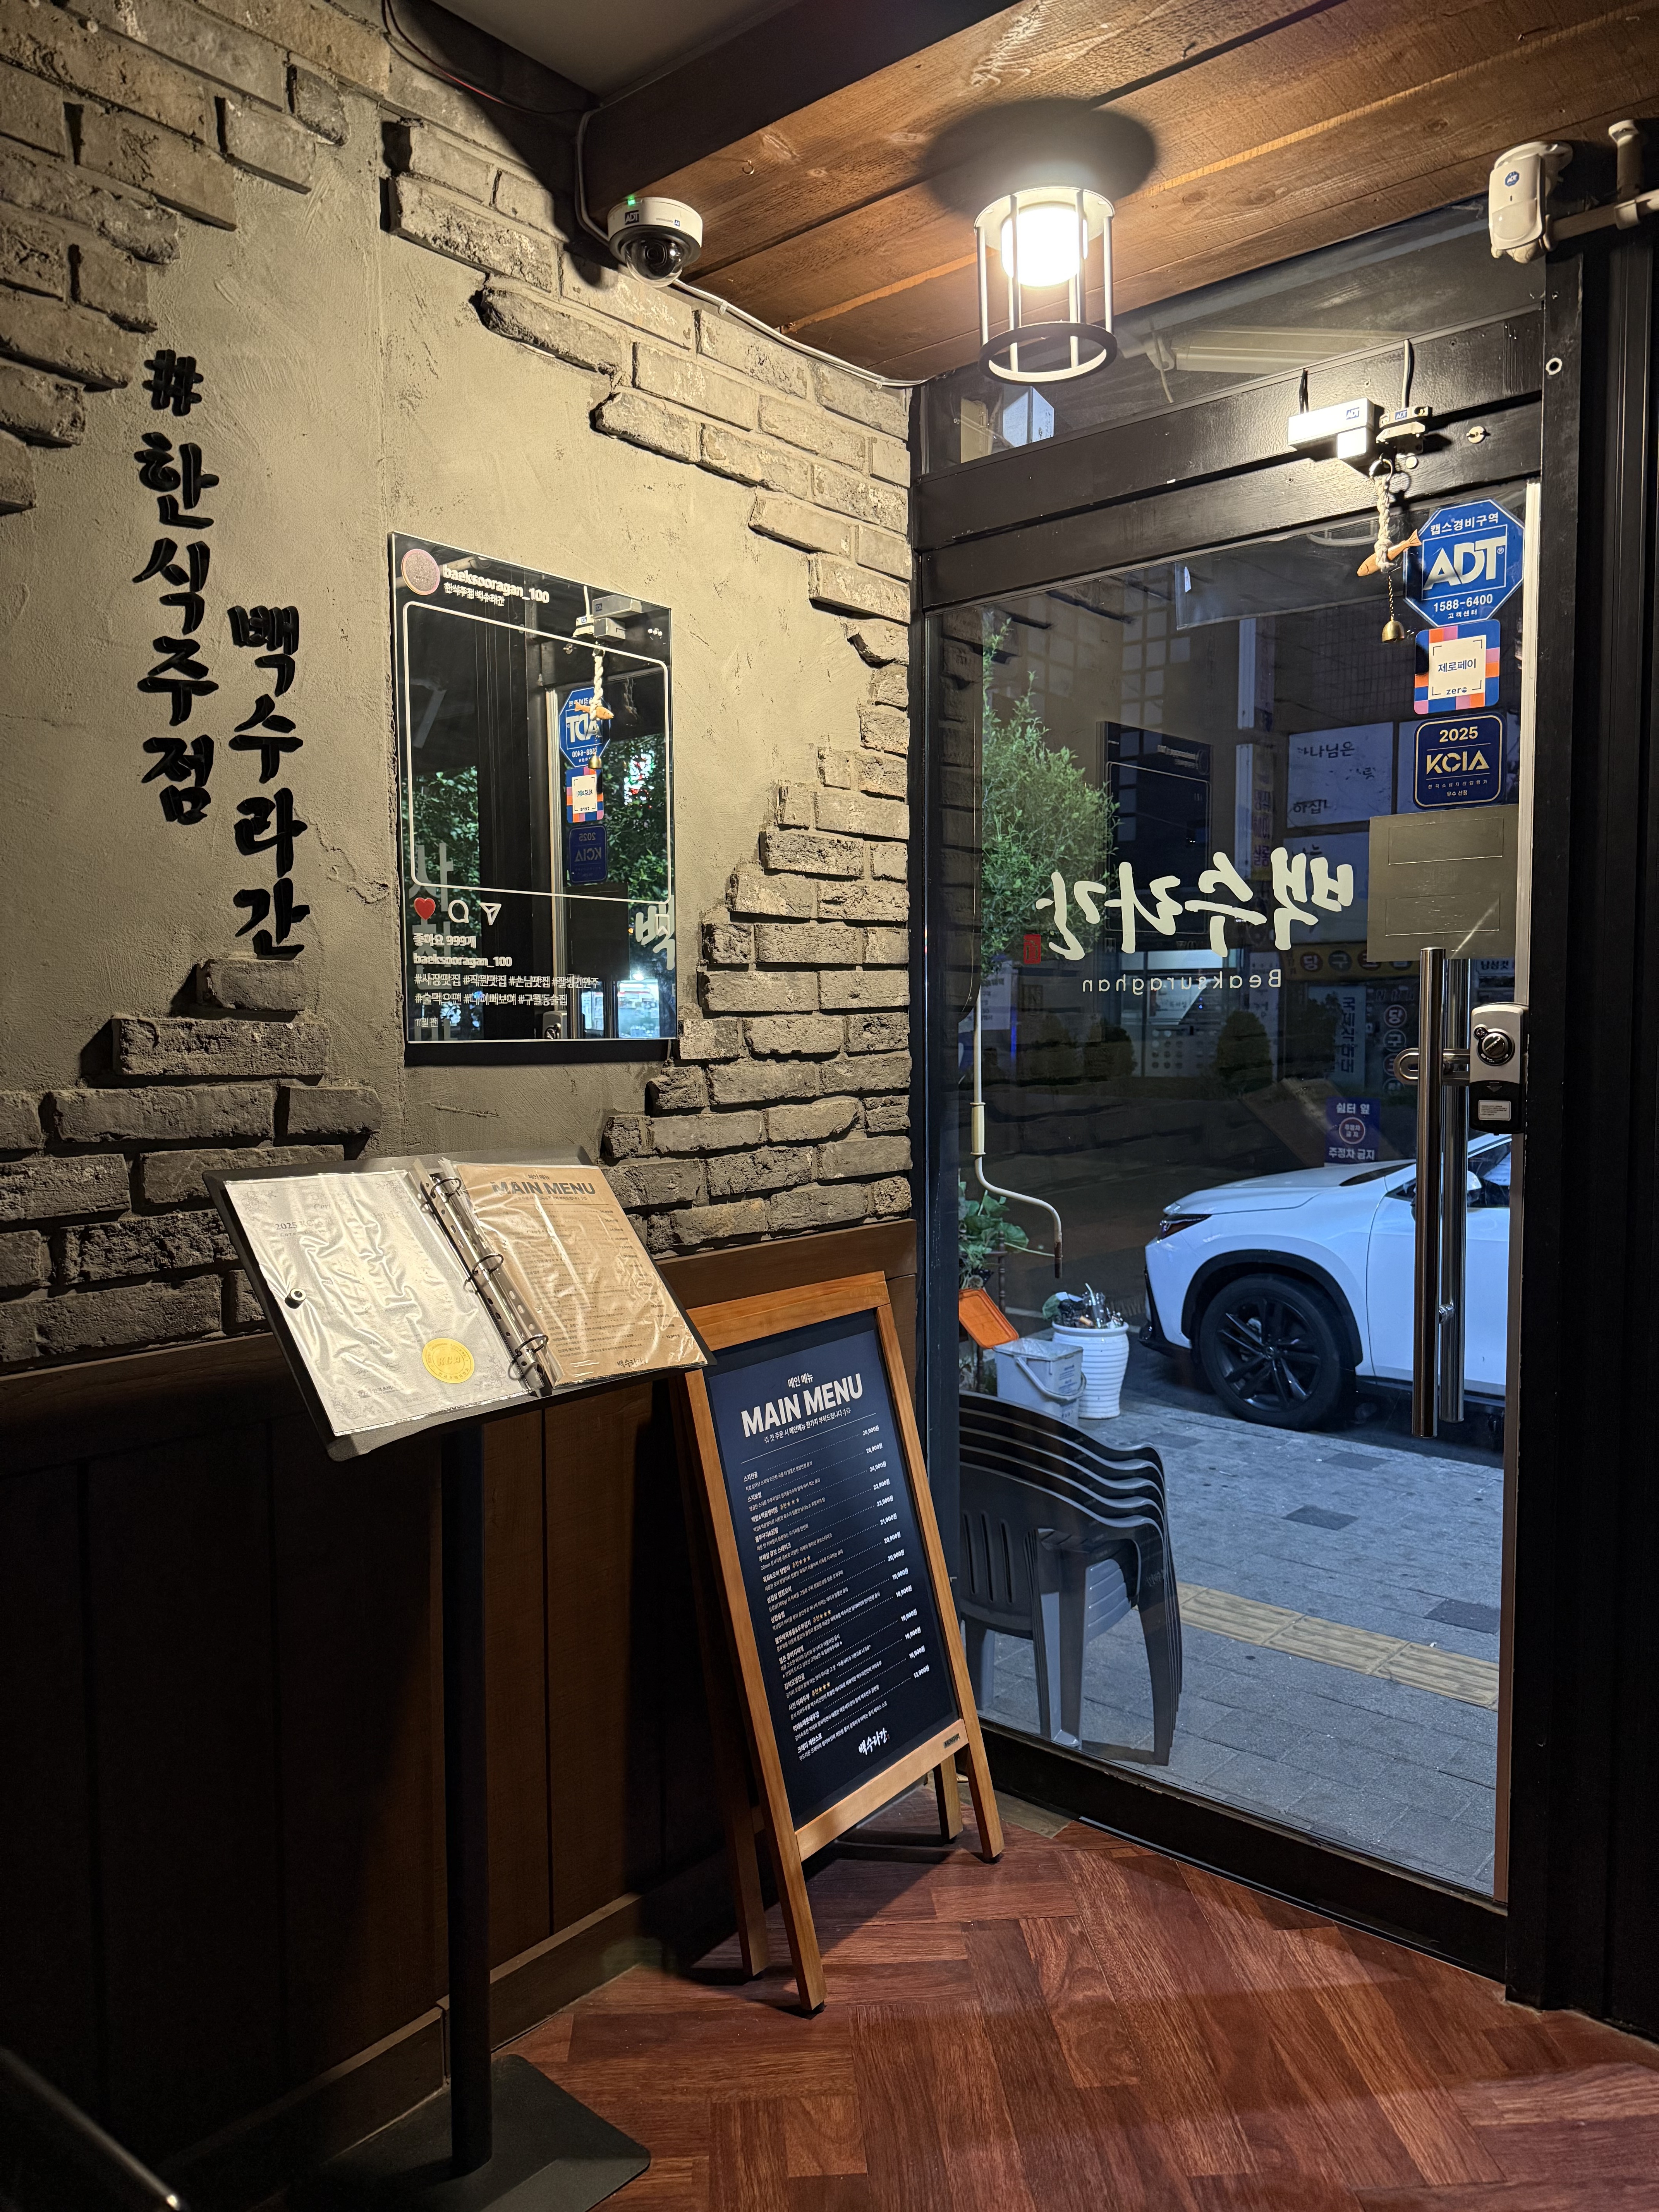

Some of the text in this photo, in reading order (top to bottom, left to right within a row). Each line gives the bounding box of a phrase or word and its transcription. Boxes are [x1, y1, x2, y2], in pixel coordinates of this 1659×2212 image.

[1346, 407, 1360, 420] ADT
[1395, 409, 1407, 420] ADT
[1431, 512, 1499, 536] 캡스경비구역
[1423, 536, 1506, 591] ADT
[132, 349, 219, 826] #한식주점
[443, 564, 550, 604] baeksooragan_100
[1433, 593, 1493, 612] 1588-6400
[1448, 610, 1478, 619] 고객센터
[1438, 658, 1477, 673] 제로페이
[1439, 726, 1479, 743] 2025
[1426, 750, 1490, 775] KCIA
[228, 605, 309, 961] 백수라간
[413, 933, 476, 948] 좋아요 999개
[413, 953, 513, 968] baeksooragan_100
[414, 973, 550, 988] #사장맛집 #직원맛집 #손님맛집
[1336, 1103, 1356, 1114] 쉼터
[1328, 1147, 1375, 1161] 주정차 금지
[490, 1181, 596, 1195] MAIN MENU
[275, 1222, 297, 1231] 2025
[787, 1373, 813, 1388] 메인 메뉴
[742, 1374, 862, 1436] MAIN MENU
[775, 1430, 783, 1439] 주문
[789, 1424, 805, 1434] 메인메뉴
[819, 1409, 842, 1423] 부탁드립니다
[744, 1471, 757, 1482] 스지전골
[777, 1542, 791, 1553] 스테이크
[767, 1592, 778, 1603] 삼겹살
[859, 1728, 887, 1755] 백수라간
